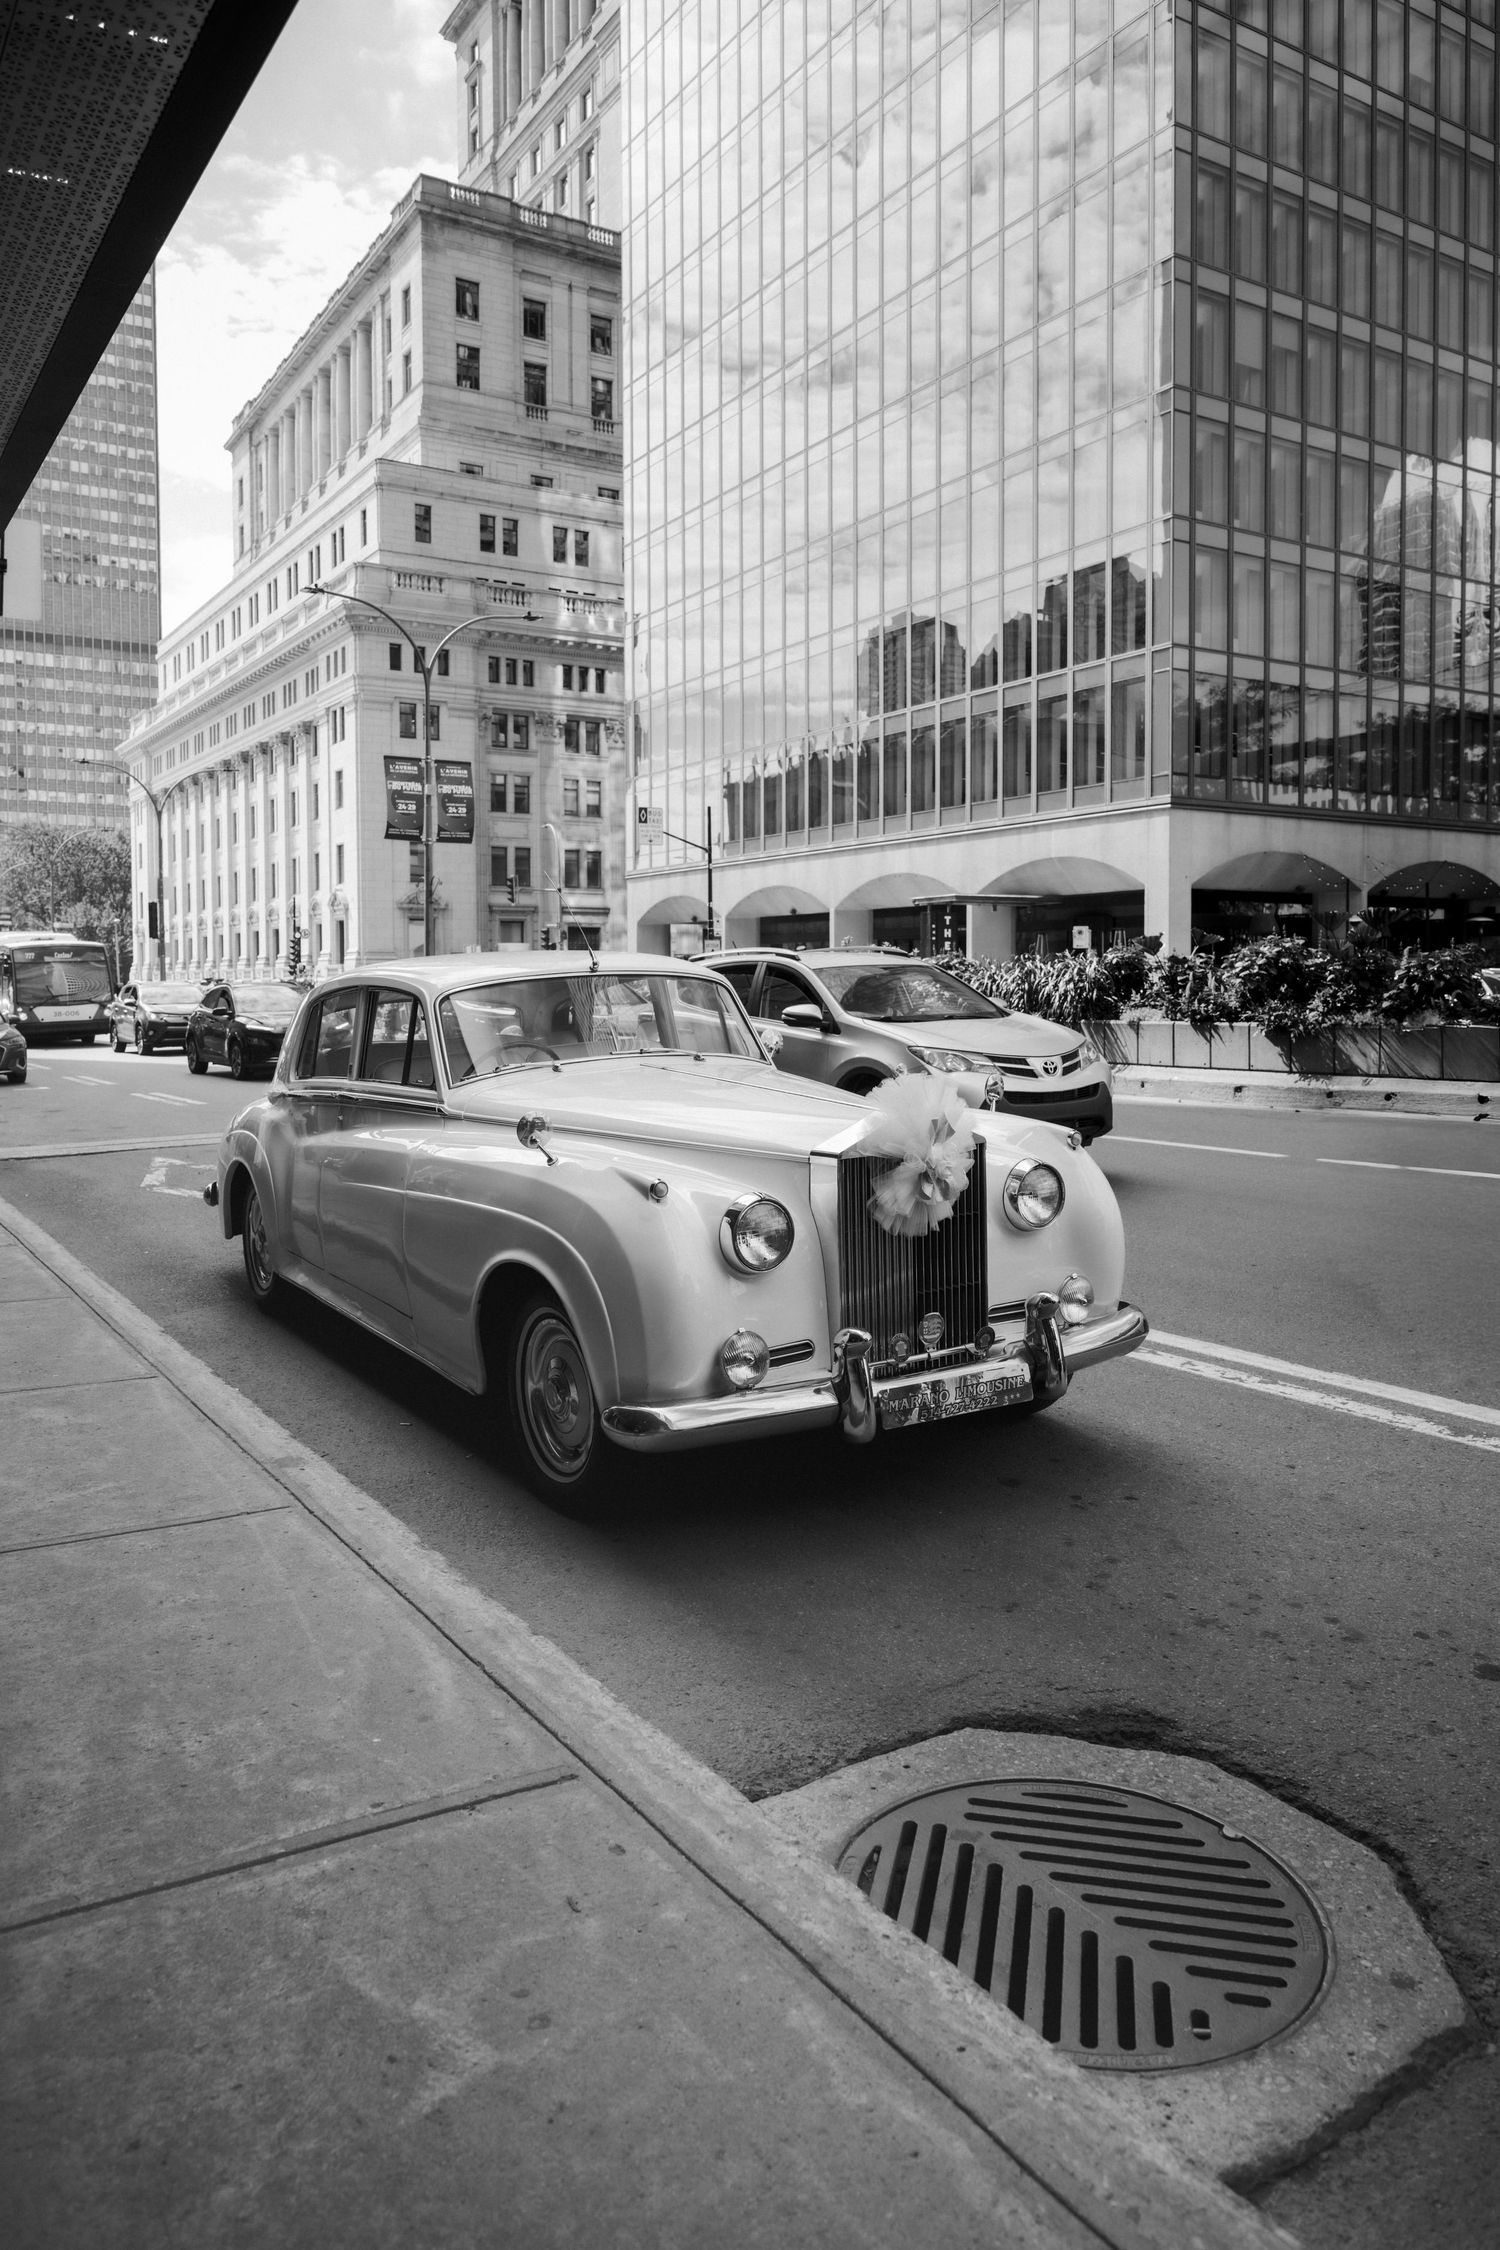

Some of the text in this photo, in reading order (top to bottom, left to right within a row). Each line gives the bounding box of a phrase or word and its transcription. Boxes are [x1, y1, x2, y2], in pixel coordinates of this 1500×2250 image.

[944, 915, 952, 950] THE
[888, 1374, 1026, 1413] MARANO LIMOUSINE
[920, 1395, 998, 1420] 514-727-4222
